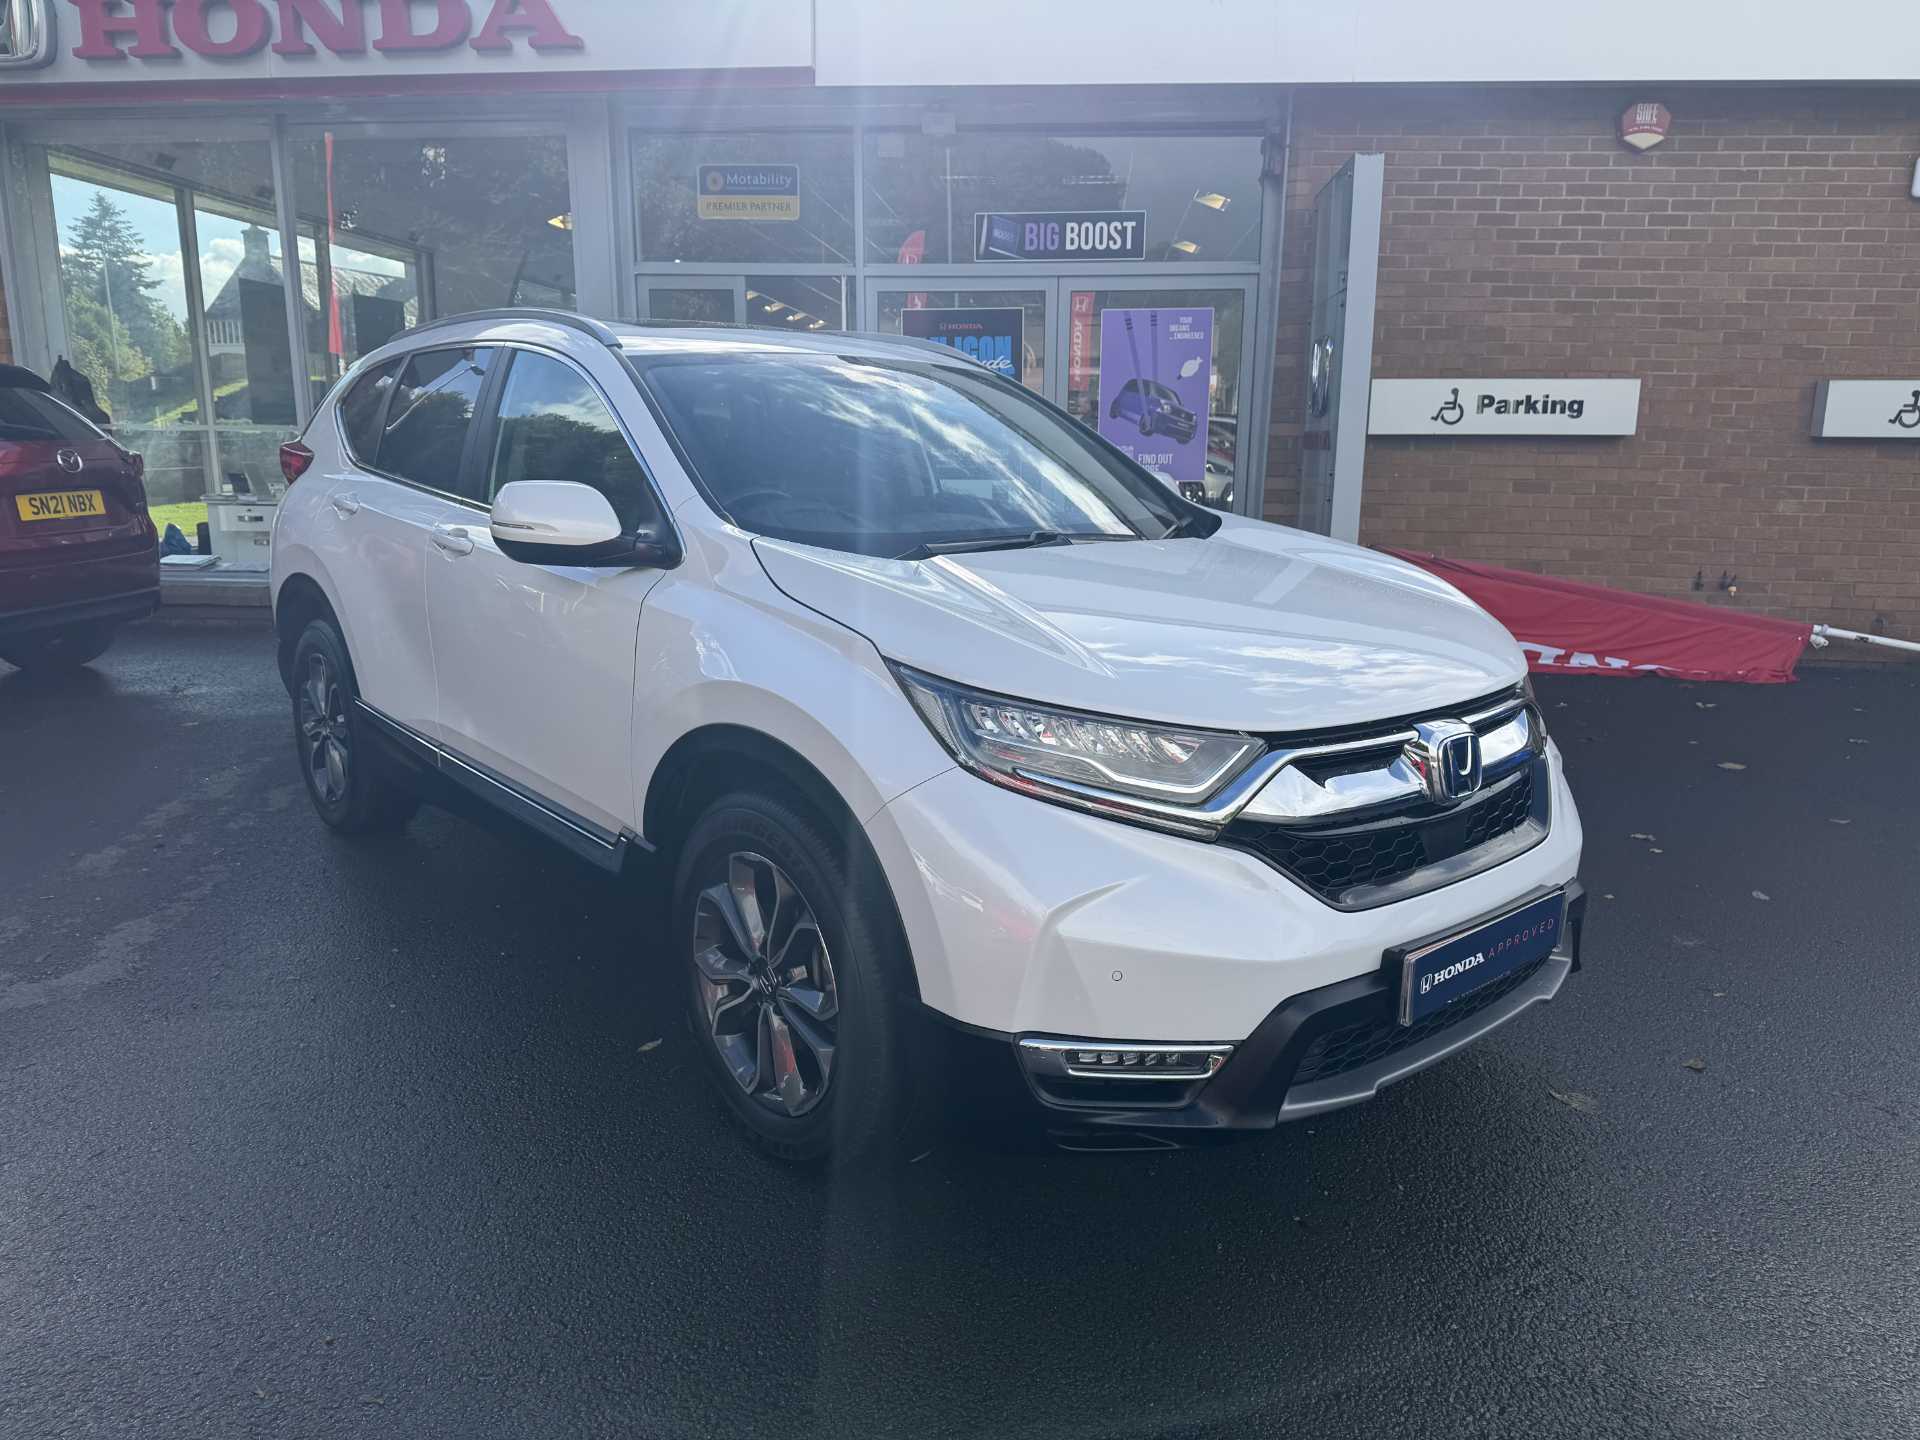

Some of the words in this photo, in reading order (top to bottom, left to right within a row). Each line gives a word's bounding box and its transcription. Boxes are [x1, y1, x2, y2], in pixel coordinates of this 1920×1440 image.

[71, 0, 586, 61] HONDA
[726, 173, 792, 189] Motability
[706, 200, 746, 211] PREMIER
[750, 200, 792, 212] PARTNER
[1024, 223, 1060, 251] BIG
[1065, 221, 1136, 250] BOOST
[1476, 394, 1584, 419] Parking
[1138, 454, 1157, 465] FIND
[1157, 453, 1174, 464] OUT
[28, 495, 66, 515] SN21
[67, 494, 96, 513] NBX
[1433, 952, 1485, 985] HONDA
[1488, 919, 1554, 959] APPROVED
